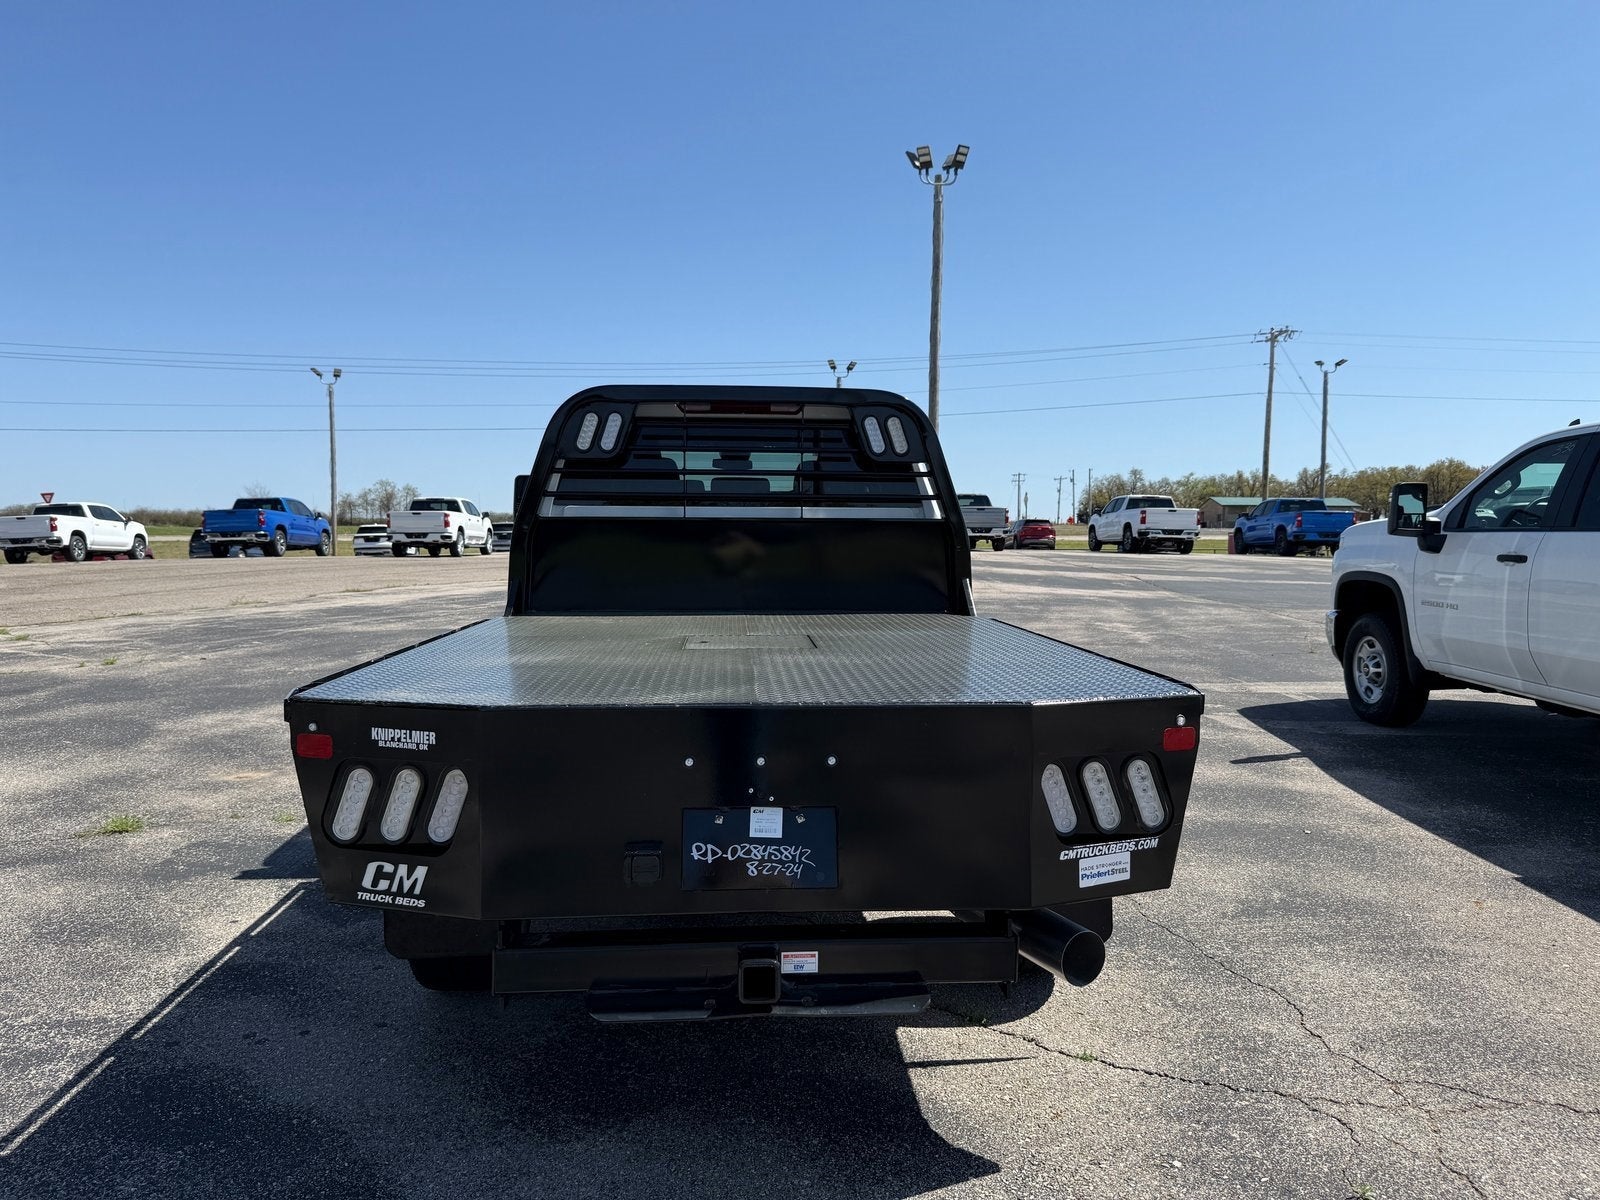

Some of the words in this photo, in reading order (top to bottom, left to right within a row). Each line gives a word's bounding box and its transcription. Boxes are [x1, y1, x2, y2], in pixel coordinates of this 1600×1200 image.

[371, 727, 436, 745] KNIPPELMIER
[378, 740, 418, 751] BLANCHARD,
[419, 743, 429, 751] OK
[691, 842, 816, 867] RD-02845842
[1060, 838, 1159, 860] CMTRUCKBEDS.COM
[746, 861, 803, 879] 8-27-24
[1080, 865, 1095, 873] MADE
[1095, 860, 1123, 870] STRONGER
[361, 861, 429, 895] CM
[357, 891, 394, 904] TRUCK
[394, 896, 426, 908] BEDS
